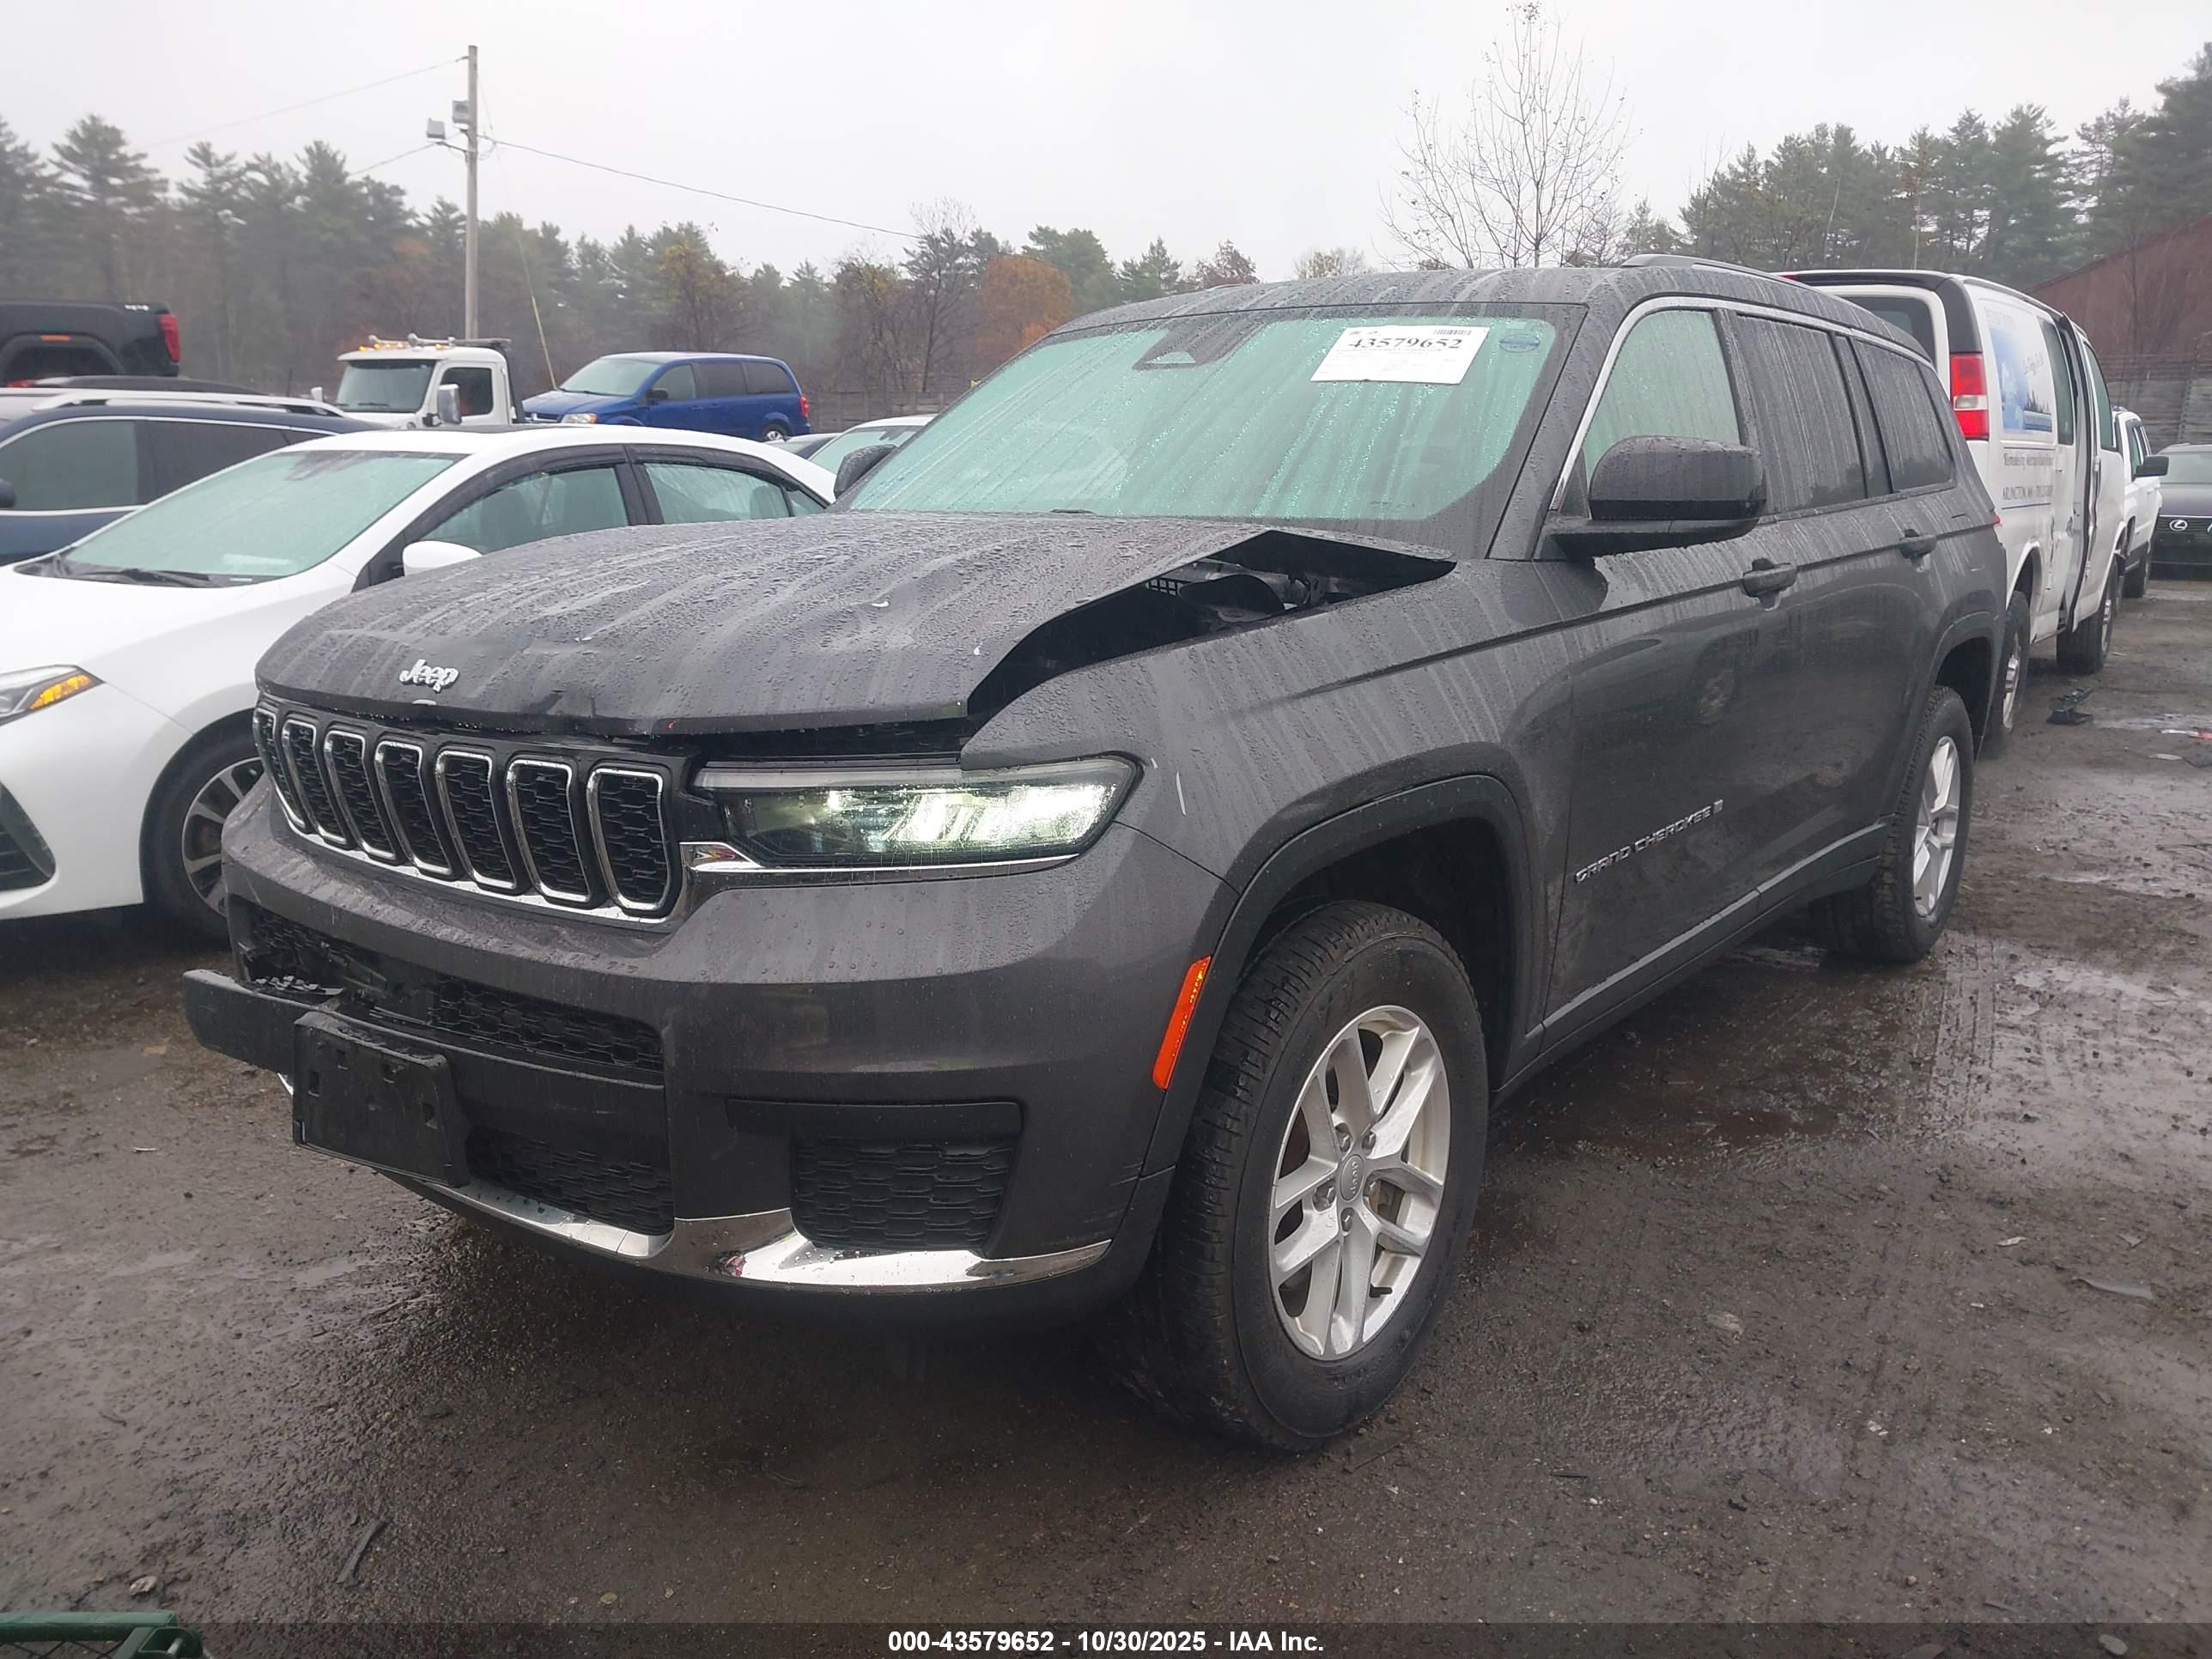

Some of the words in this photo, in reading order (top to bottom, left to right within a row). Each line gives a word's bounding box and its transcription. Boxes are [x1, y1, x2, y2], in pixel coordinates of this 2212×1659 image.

[1348, 337, 1463, 349] 43579652
[399, 659, 459, 693] Jeep
[1576, 846, 1631, 884] GRAND
[1635, 805, 1711, 852] CHEROKEE
